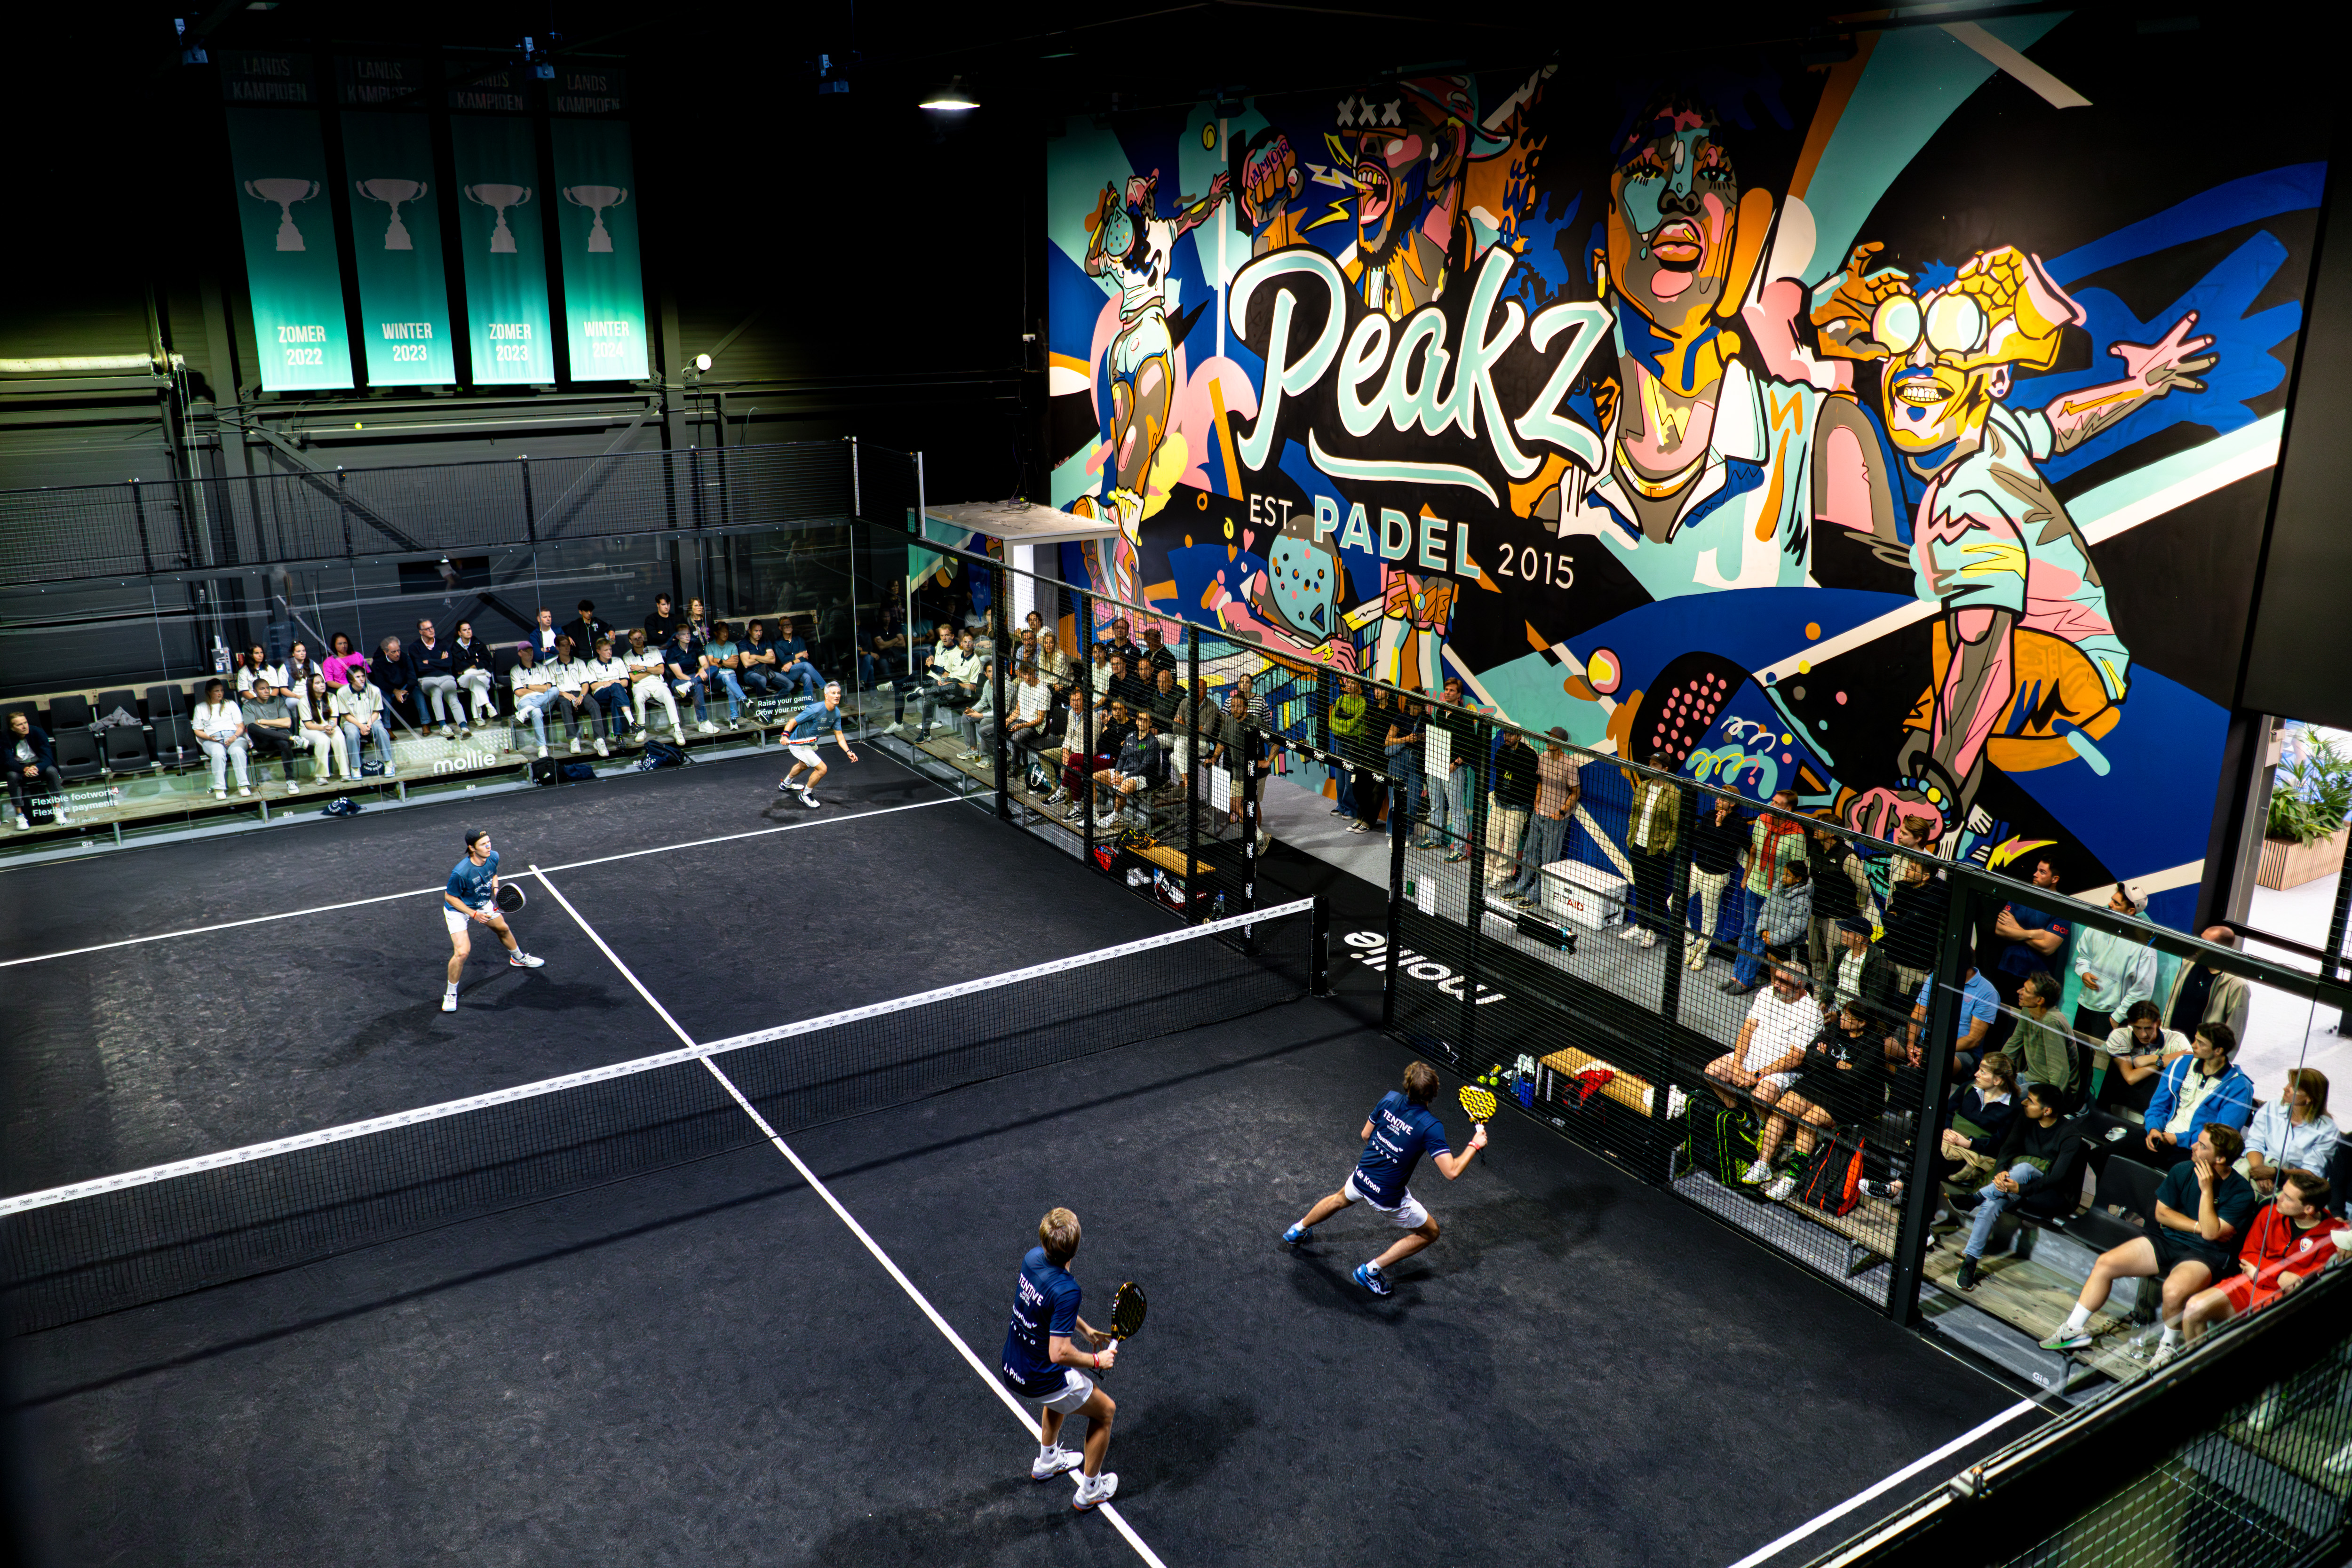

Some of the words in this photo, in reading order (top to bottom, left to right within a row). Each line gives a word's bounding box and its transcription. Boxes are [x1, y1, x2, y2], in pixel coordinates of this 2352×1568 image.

[243, 57, 290, 76] LANDS
[358, 62, 403, 79] LANDS
[232, 81, 307, 102] KAMPIOEN
[567, 74, 606, 92] LANDS
[458, 92, 523, 111] KAMPIOEN
[1252, 143, 1290, 183] AMOR
[278, 326, 326, 343] ZOMER
[382, 323, 432, 340] WINTER
[489, 324, 531, 340] ZOMER
[584, 321, 629, 337] WINTER
[286, 349, 323, 366] 2022
[393, 345, 427, 361] 2023
[496, 345, 528, 361] 2023
[593, 342, 624, 358] 2024
[1230, 246, 1614, 478] Peakz
[1314, 494, 1480, 580] PADEL
[1498, 543, 1574, 589] 2015
[1286, 740, 1296, 749] Peakz
[434, 749, 496, 773] mollie
[1343, 761, 1354, 770] Peakz
[1372, 773, 1384, 781] Peakz
[31, 795, 69, 806] Flexible
[71, 788, 113, 801] footwork
[72, 799, 119, 812] payments
[1553, 892, 1584, 911] FITAID
[1357, 1170, 1364, 1179] de
[1363, 1175, 1381, 1194] Kroon
[1003, 1362, 1009, 1373] J.
[1009, 1367, 1025, 1385] Prins
